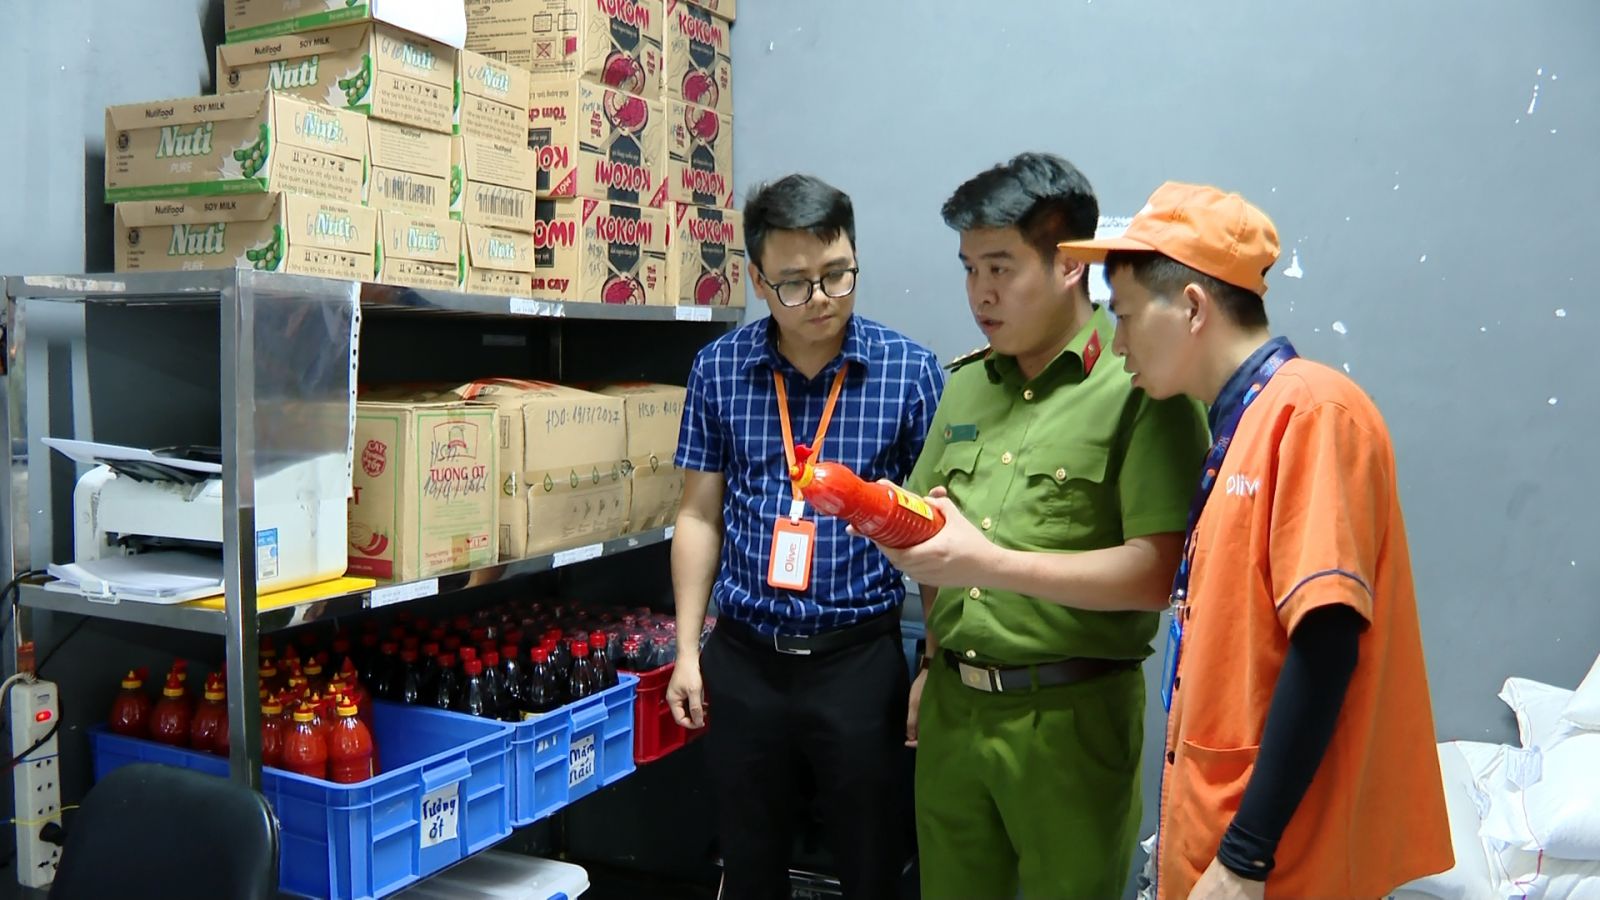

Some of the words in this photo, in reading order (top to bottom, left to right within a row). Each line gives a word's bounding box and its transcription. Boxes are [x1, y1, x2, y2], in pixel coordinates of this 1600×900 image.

[299, 40, 312, 48] SOY
[313, 37, 330, 46] MILK
[679, 12, 722, 47] KOKOMI
[268, 55, 318, 90] Nuti
[193, 104, 207, 113] SOY
[207, 102, 225, 111] MILK
[156, 122, 213, 159] Nuti
[595, 160, 651, 193] KOKOMI
[682, 168, 725, 196] KOKOMI
[204, 203, 218, 211] SOY
[219, 201, 236, 210] MILK
[168, 223, 226, 256] Nuti
[534, 220, 576, 248] OMI
[596, 216, 652, 245] KOKOMI
[689, 218, 734, 246] KOKOMI
[547, 278, 569, 293] cay
[1225, 473, 1262, 496] Oliv
[784, 543, 797, 572] Olive
